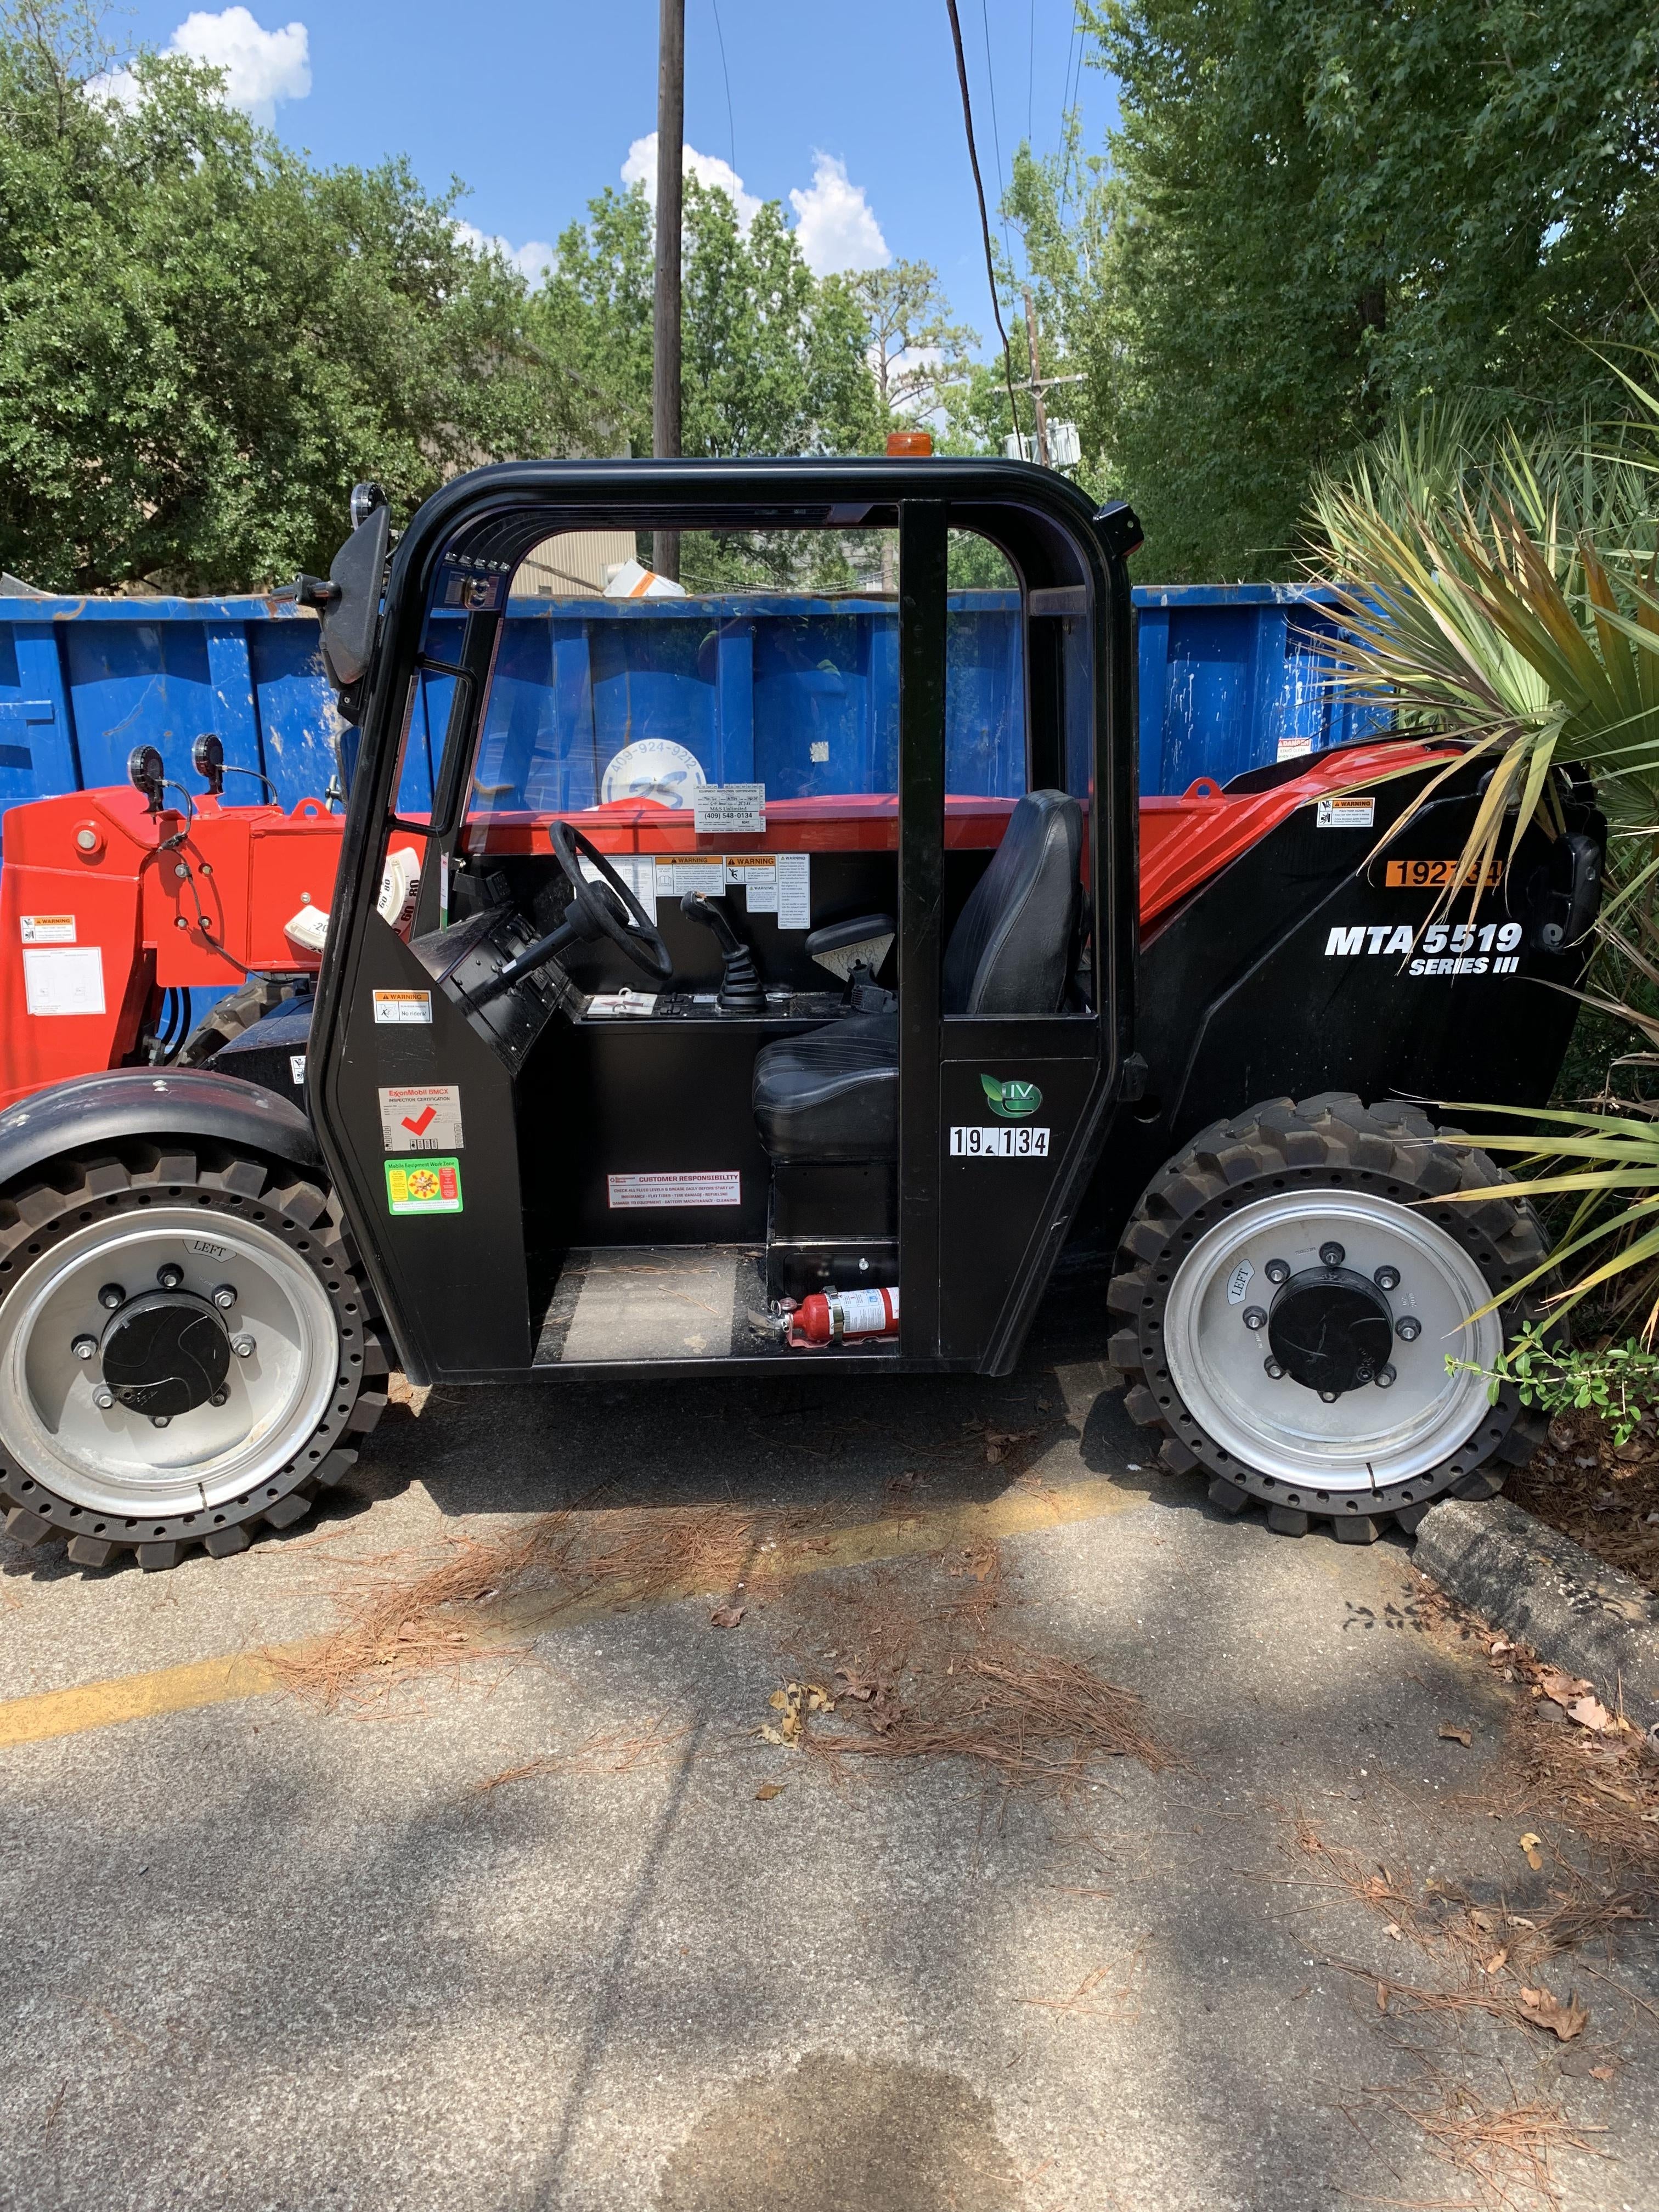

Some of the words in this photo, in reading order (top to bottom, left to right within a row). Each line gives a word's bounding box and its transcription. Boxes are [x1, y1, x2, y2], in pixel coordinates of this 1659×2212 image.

[611, 742, 696, 772] 409-924-9212
[1397, 861, 1501, 884] 19234
[1324, 926, 1414, 956] MTA
[1423, 923, 1522, 953] 5519
[1409, 957, 1489, 975] SERIES
[1492, 957, 1520, 973] III
[194, 1240, 227, 1257] LEFT
[1231, 1268, 1249, 1296] LEFT
